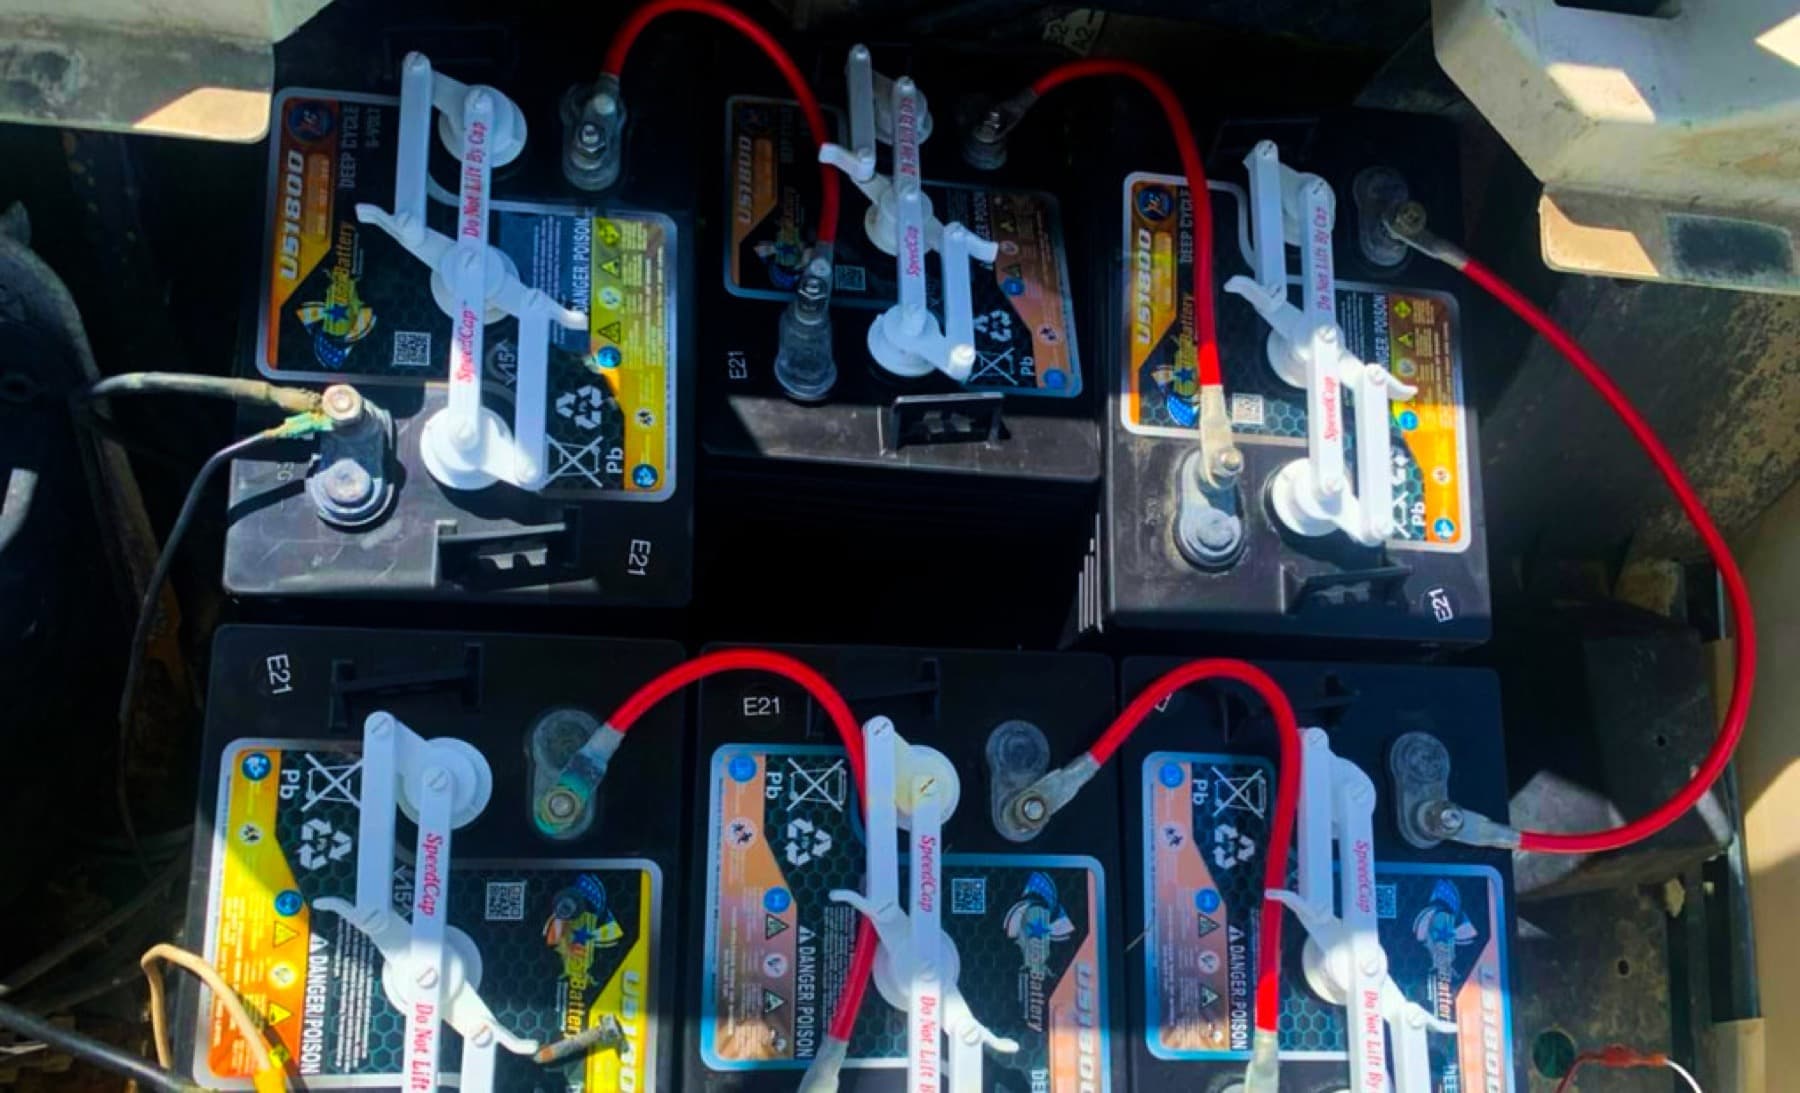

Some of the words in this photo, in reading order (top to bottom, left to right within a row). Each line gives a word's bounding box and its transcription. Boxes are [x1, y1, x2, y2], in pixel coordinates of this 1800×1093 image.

[468, 121, 486, 145] Cap
[464, 167, 481, 193] Lift
[280, 149, 304, 281] US1800
[463, 196, 479, 217] Not
[463, 219, 479, 237] Do
[572, 218, 590, 260] POISON
[1136, 228, 1151, 345] US1800
[457, 310, 476, 383] SpeedCap
[728, 350, 747, 380] E21
[1020, 356, 1034, 378] Pb
[606, 447, 623, 474] Pb
[1411, 502, 1425, 525] Pb
[627, 539, 651, 577] E21
[1428, 588, 1453, 623] E21
[267, 654, 292, 694] E21
[743, 696, 782, 717] E21
[280, 769, 299, 799] Pb
[766, 771, 783, 799] Pb
[1192, 778, 1208, 806] Pb
[416, 833, 443, 916] SpeedCap
[918, 834, 937, 913] SpeedCap
[305, 955, 329, 1015] DANGER
[798, 945, 816, 1001] DANGER
[1229, 945, 1246, 996] DANGER
[415, 1003, 434, 1025] Do
[920, 995, 936, 1016] Do
[1026, 970, 1046, 1033] Battery
[1364, 990, 1380, 1009] Do
[796, 1005, 815, 1059] POISON
[920, 1020, 936, 1043] Not
[1230, 1001, 1248, 1050] POISON
[1365, 1012, 1380, 1035] Not
[300, 1018, 325, 1074] POISON
[414, 1028, 433, 1053] Not
[1366, 1040, 1382, 1067] Lift
[411, 1060, 431, 1092] Lift
[919, 1050, 936, 1078] Lift
[1367, 1071, 1384, 1089] By
